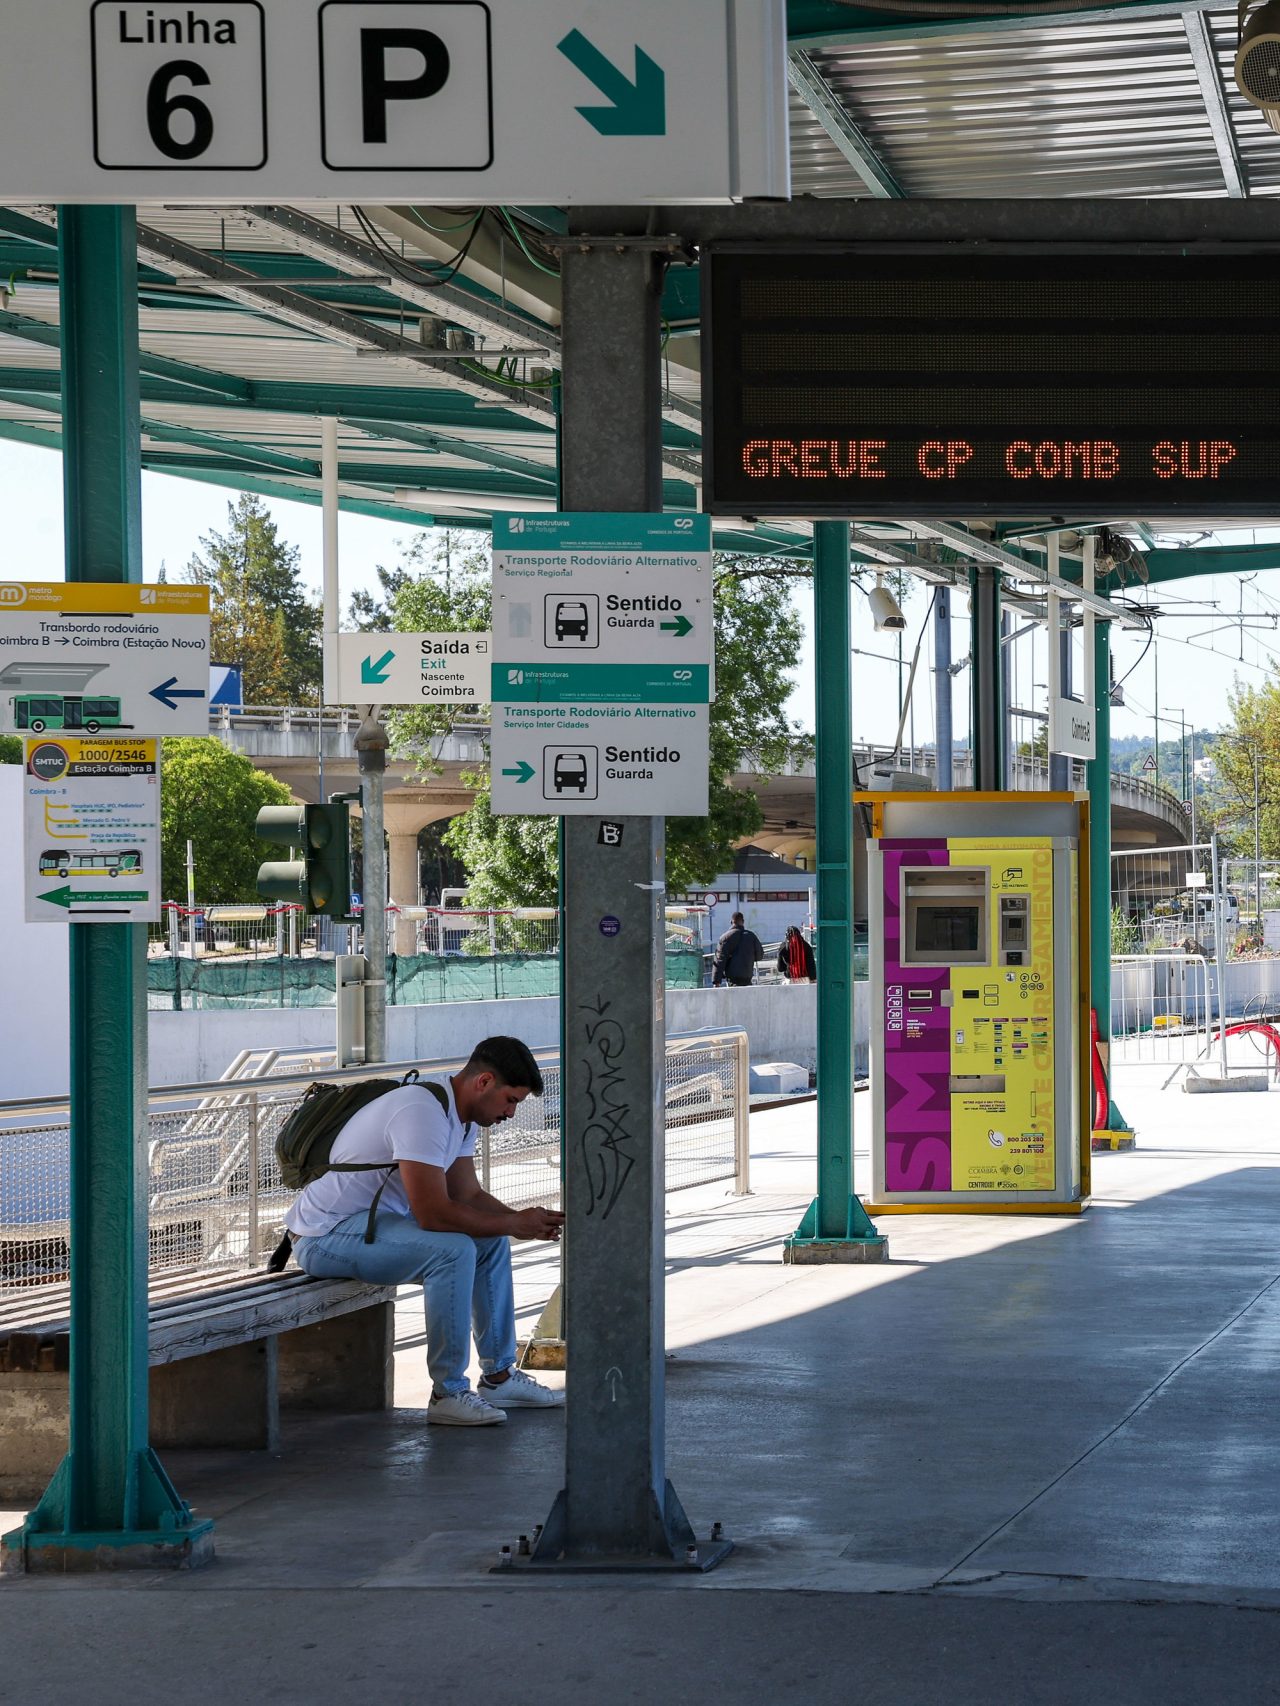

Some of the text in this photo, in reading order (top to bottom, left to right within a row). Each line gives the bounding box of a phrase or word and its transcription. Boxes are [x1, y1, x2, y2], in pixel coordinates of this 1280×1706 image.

[118, 11, 237, 44] Linha
[360, 27, 450, 144] P
[146, 59, 214, 160] 6
[743, 440, 1237, 478] GREVE CP COMB SUP
[526, 519, 570, 527] Infraestruturas
[505, 555, 697, 567] Transporte Rodoviário Alternativo
[505, 569, 572, 578] Serviço Regional
[606, 594, 682, 612] Sentido
[39, 622, 159, 634] Transbordo rodoviário
[607, 617, 655, 628] Guarda
[0, 636, 206, 650] oimbra B Coimbra (Estação Nova)
[421, 639, 469, 654] Saída
[421, 658, 446, 669] Exit
[421, 673, 465, 681] Nascente
[421, 685, 475, 696] Coimbra
[504, 706, 696, 719] Transporte Rodoviário Alternativo
[504, 721, 535, 729] Serviço
[557, 721, 589, 729] Cidades
[79, 750, 146, 762] 1000/2546
[605, 745, 681, 763] Sentido
[74, 764, 107, 773] Estação
[108, 765, 145, 773] Coimbra
[605, 768, 653, 780] Guarda
